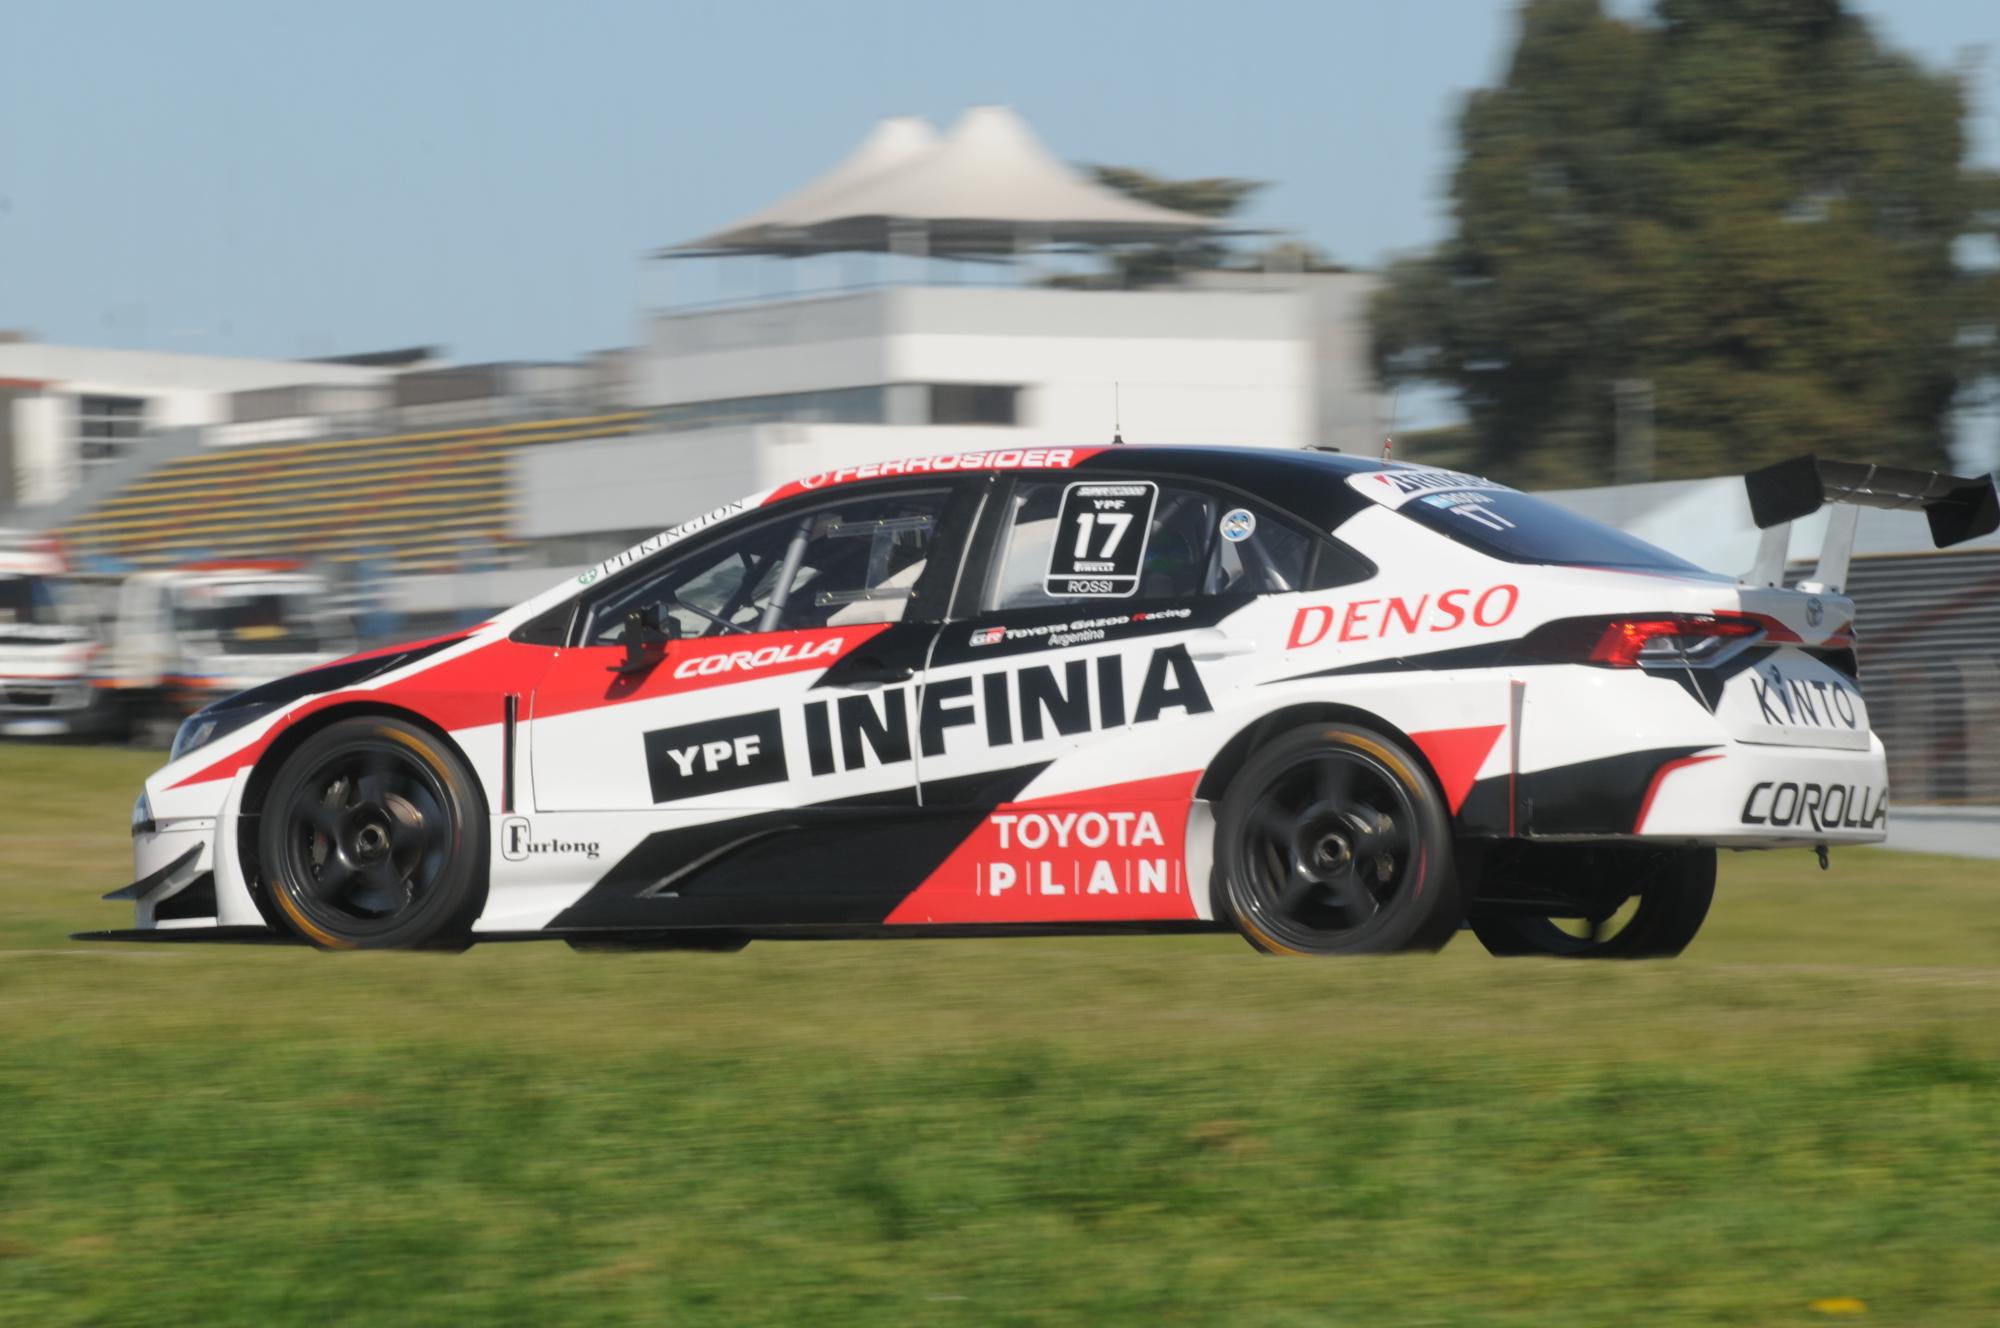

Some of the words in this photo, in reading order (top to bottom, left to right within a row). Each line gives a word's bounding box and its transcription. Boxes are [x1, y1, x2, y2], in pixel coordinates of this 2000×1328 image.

[833, 449, 1074, 484] FERROSIDER
[1093, 499, 1126, 510] YPF
[1449, 503, 1517, 531] 17
[602, 499, 745, 575] PILKINGTON
[1073, 512, 1134, 559] 17
[1067, 580, 1113, 593] ROSSI
[1132, 608, 1192, 622] Racing
[1286, 584, 1519, 650] DENSO
[673, 637, 844, 679] COROLLA
[1048, 629, 1105, 647] Argentina
[803, 643, 1214, 777] INFINIA
[1750, 664, 1856, 729] KINTO
[667, 734, 761, 777] YPF
[1740, 781, 1888, 832] COROLLA
[508, 825, 600, 858] Furlong
[991, 811, 1165, 849] TOYOTA
